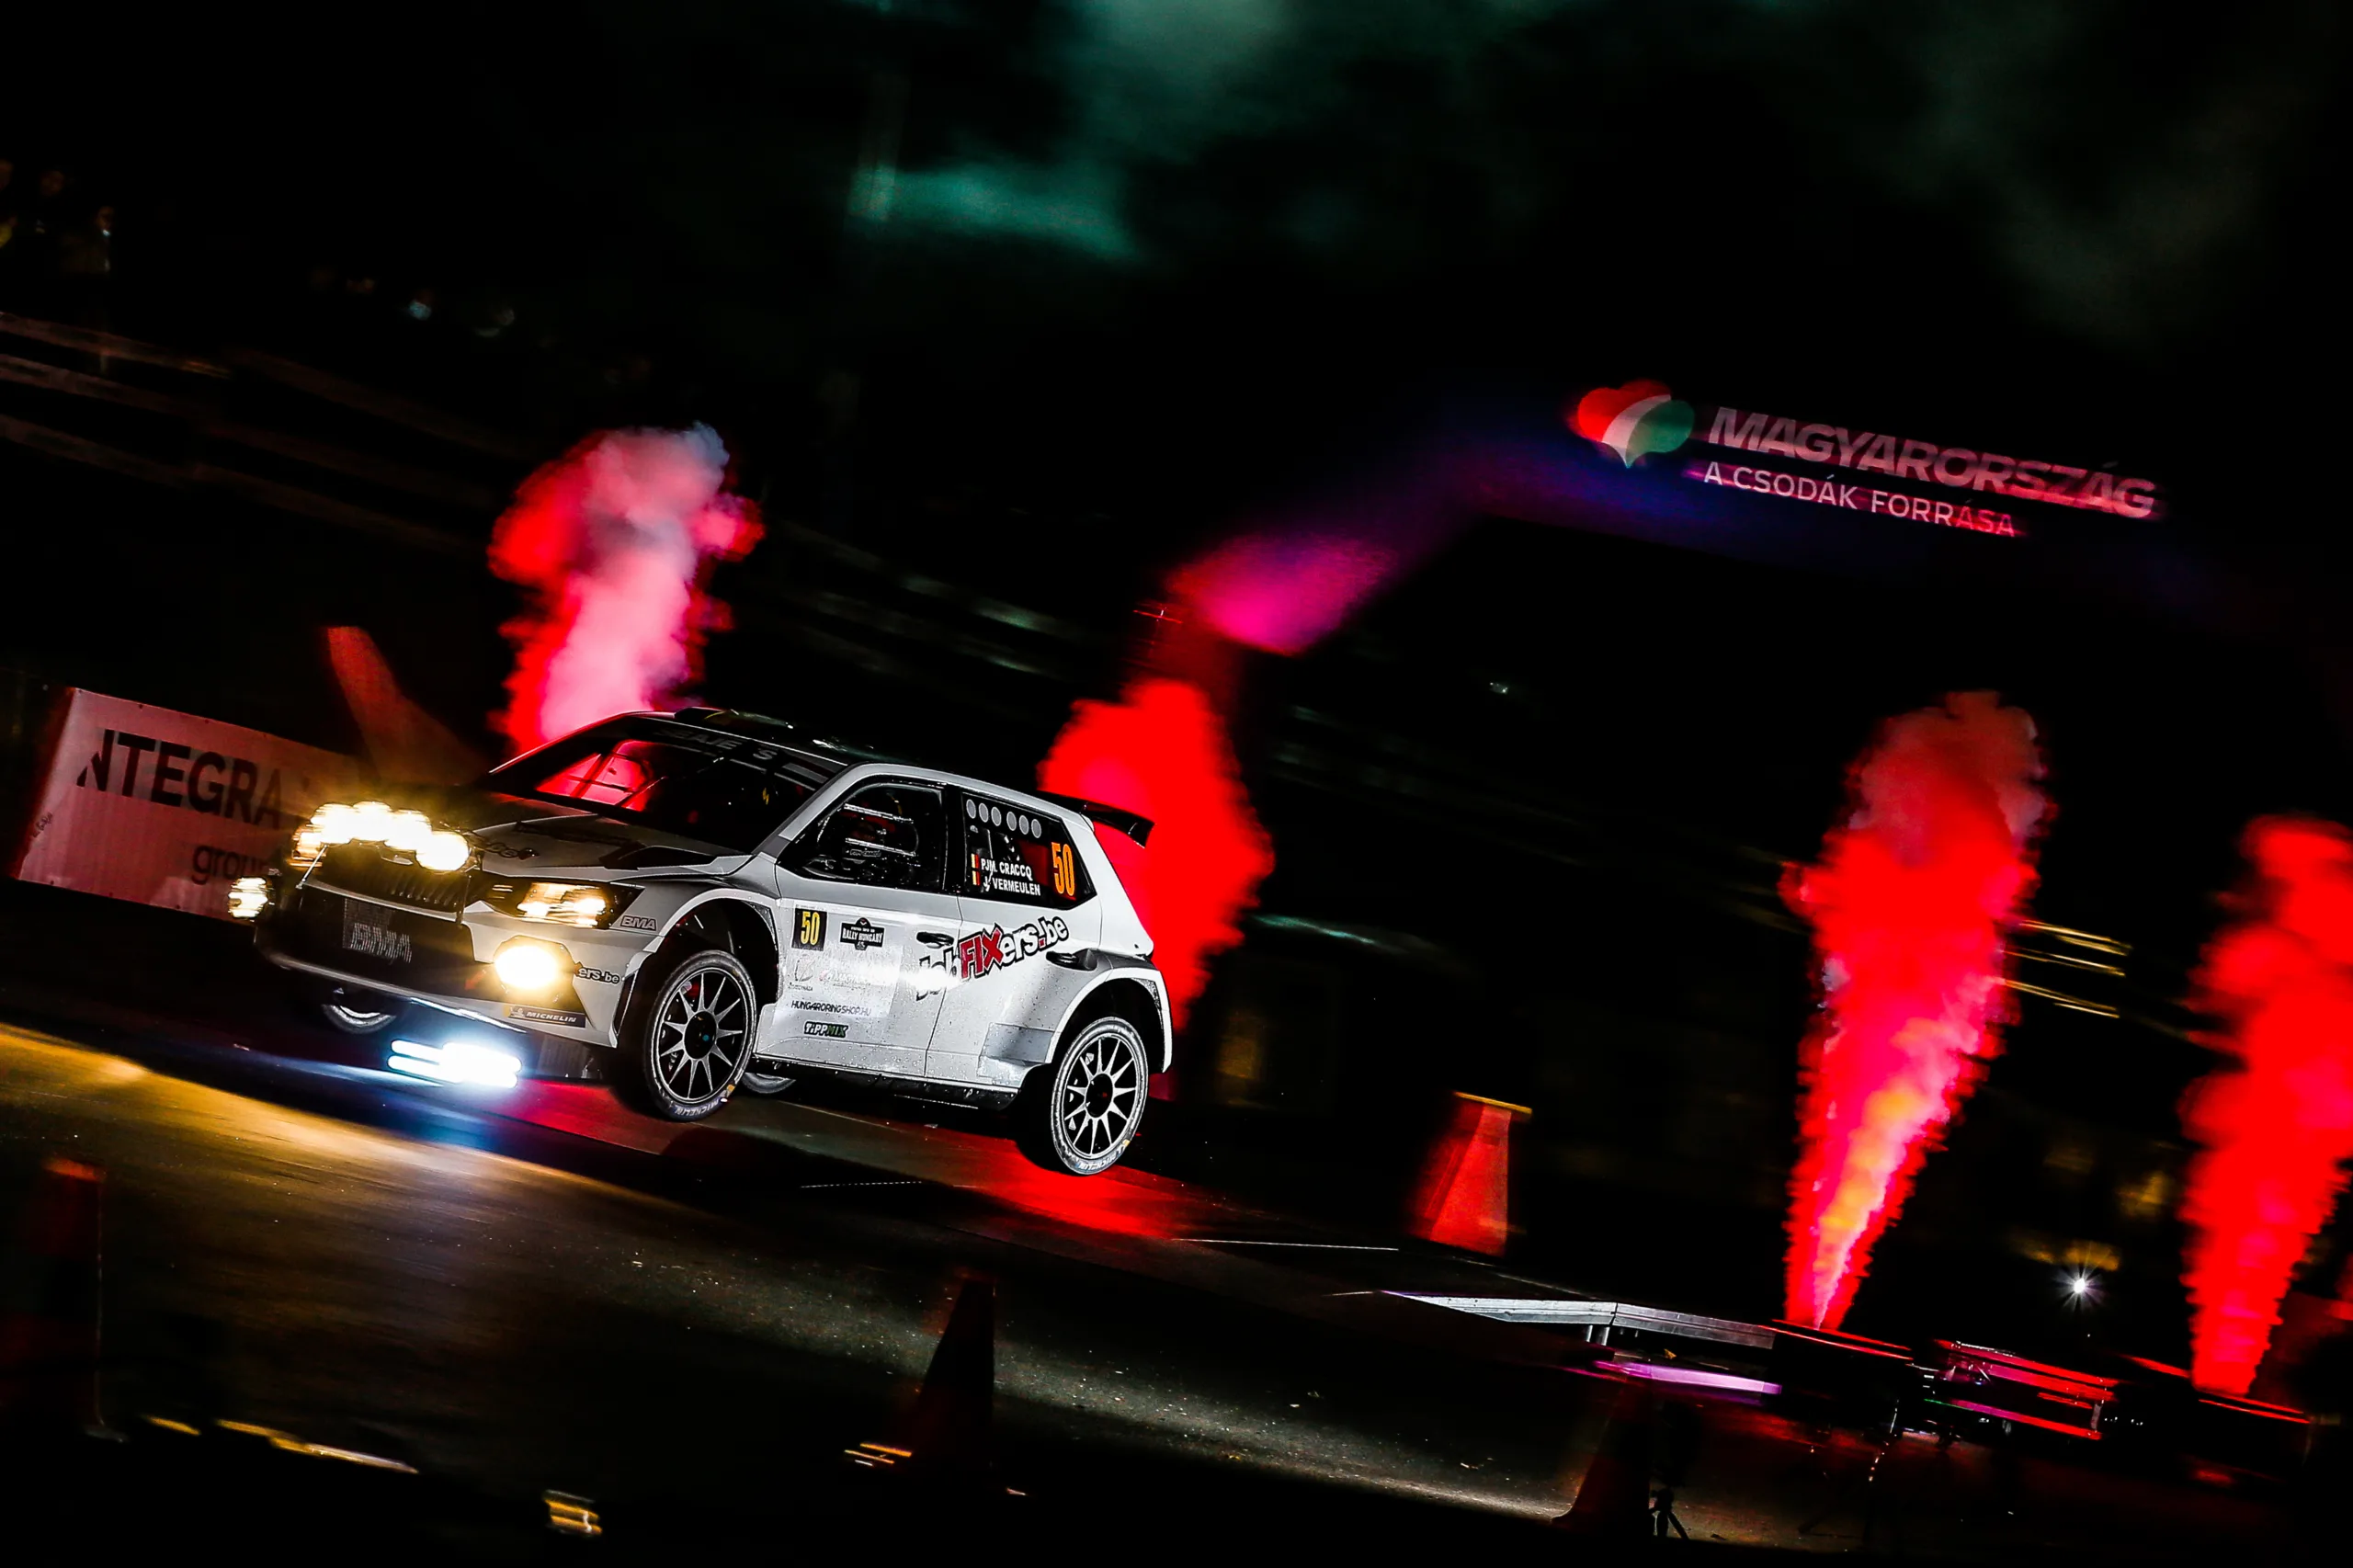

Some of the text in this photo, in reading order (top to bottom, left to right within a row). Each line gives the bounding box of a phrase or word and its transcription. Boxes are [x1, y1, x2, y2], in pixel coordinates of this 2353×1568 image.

[1708, 406, 2155, 518] MAGYARORSZÁG
[1703, 461, 2016, 538] A CSODÁK FORRÁSA
[191, 845, 269, 885] grou
[1051, 841, 1075, 897] 50
[992, 877, 1041, 896] VERMEULEN
[620, 915, 656, 931] BMA
[800, 910, 821, 946] 50
[842, 927, 858, 940] RALLY
[858, 932, 883, 944] HUNGARY
[526, 1011, 577, 1023] MICHELIN
[675, 1098, 719, 1117] MICHELIN
